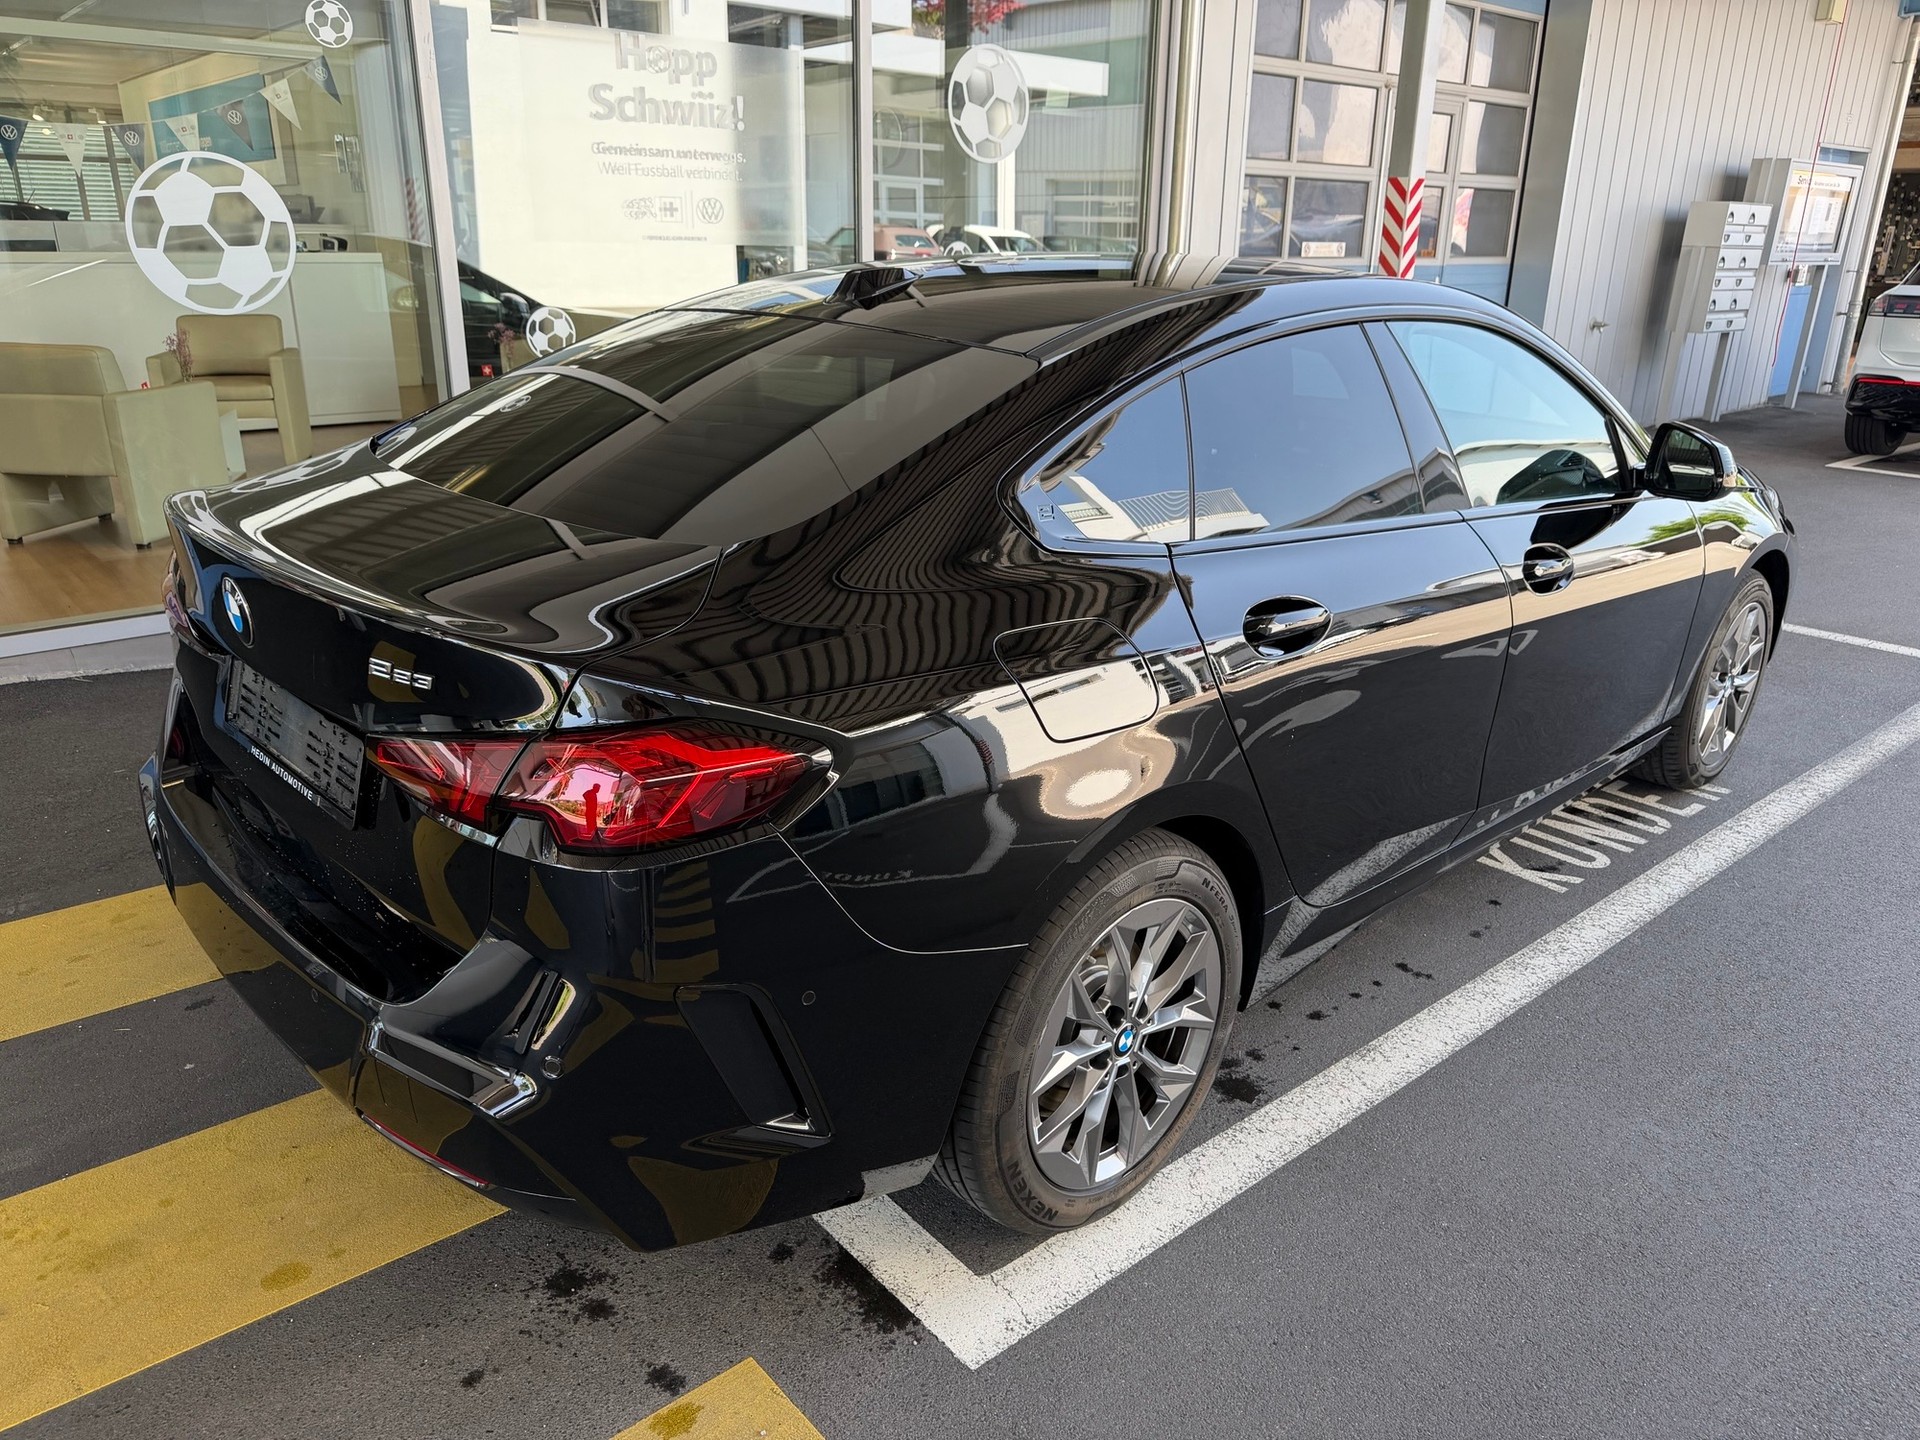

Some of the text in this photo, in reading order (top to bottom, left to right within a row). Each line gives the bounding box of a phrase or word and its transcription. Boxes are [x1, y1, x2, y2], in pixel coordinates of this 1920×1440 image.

[615, 32, 718, 87] Hopp
[591, 141, 674, 158] Gemeinsam
[597, 161, 632, 176] Weil
[369, 657, 433, 690] 223
[250, 745, 314, 801] HEDIN AUTOMOTIVE
[1006, 1160, 1059, 1222] NEXEN
